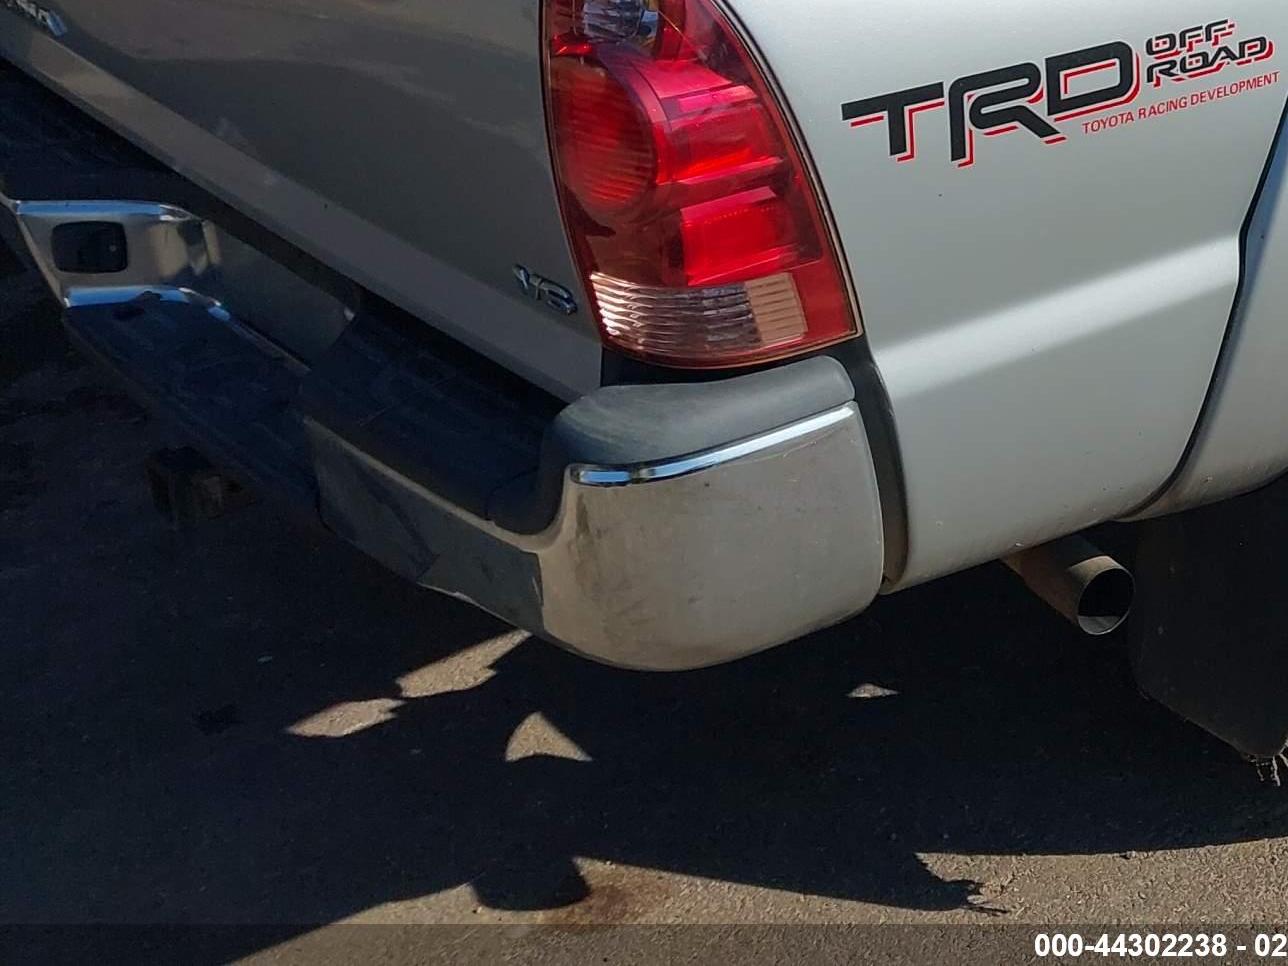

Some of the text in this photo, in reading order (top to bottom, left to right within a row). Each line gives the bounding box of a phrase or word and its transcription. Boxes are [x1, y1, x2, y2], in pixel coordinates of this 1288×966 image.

[1145, 18, 1236, 59] OFF
[1146, 34, 1276, 88] ROAD
[840, 40, 1140, 169] TRD
[1082, 71, 1281, 136] TOYOTA RACING DEVELOPMENT
